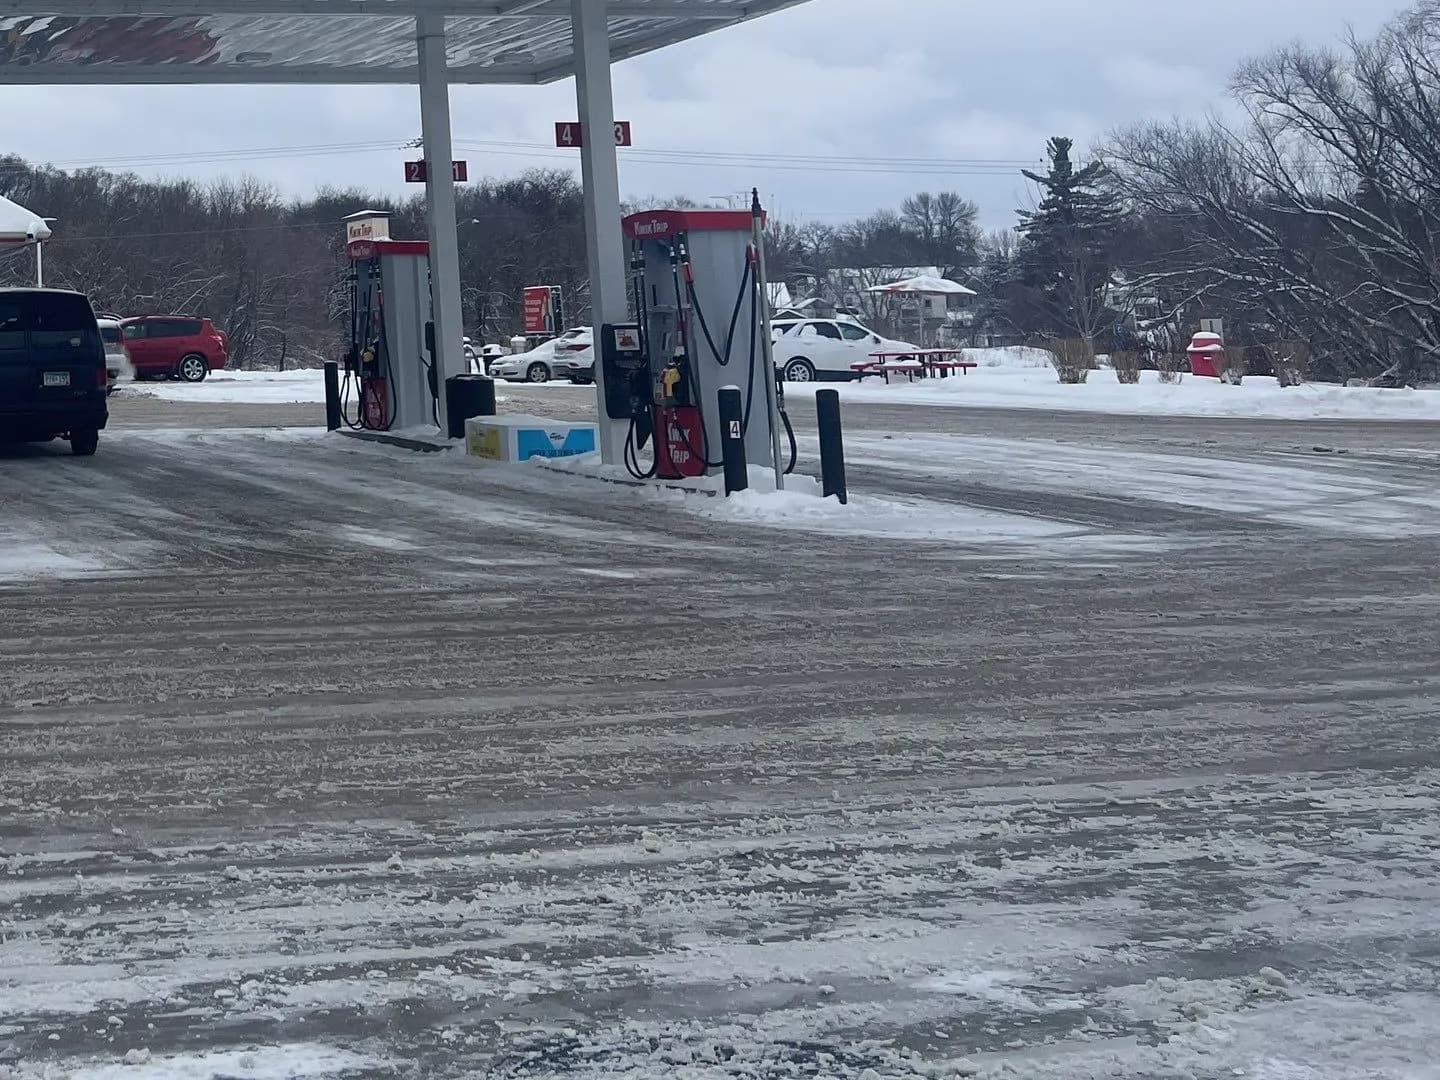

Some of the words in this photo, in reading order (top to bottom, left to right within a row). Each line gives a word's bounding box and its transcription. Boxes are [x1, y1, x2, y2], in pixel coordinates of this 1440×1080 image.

[561, 124, 573, 145] 4
[614, 124, 624, 145] 3
[411, 163, 420, 181] 2
[452, 162, 459, 180] 1
[730, 421, 740, 437] 4
[668, 444, 690, 464] TRIP
